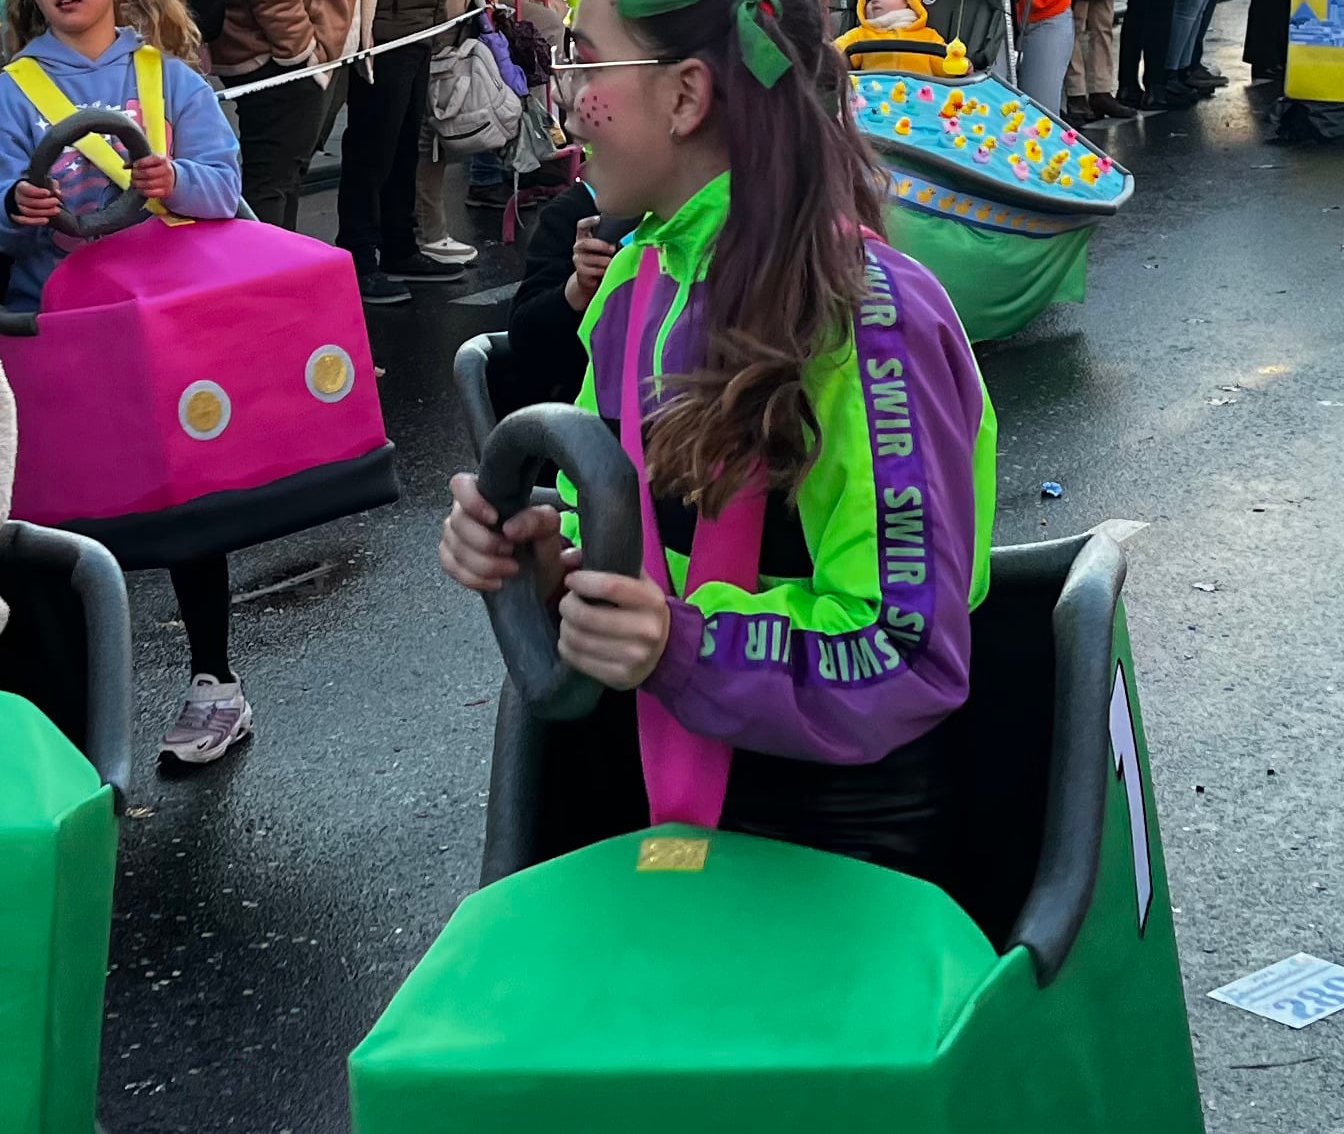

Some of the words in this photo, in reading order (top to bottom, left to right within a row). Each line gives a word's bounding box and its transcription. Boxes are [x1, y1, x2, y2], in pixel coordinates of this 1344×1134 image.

[866, 357, 914, 457] SWIR
[883, 486, 926, 585] SWIR
[817, 629, 900, 682] SWIR
